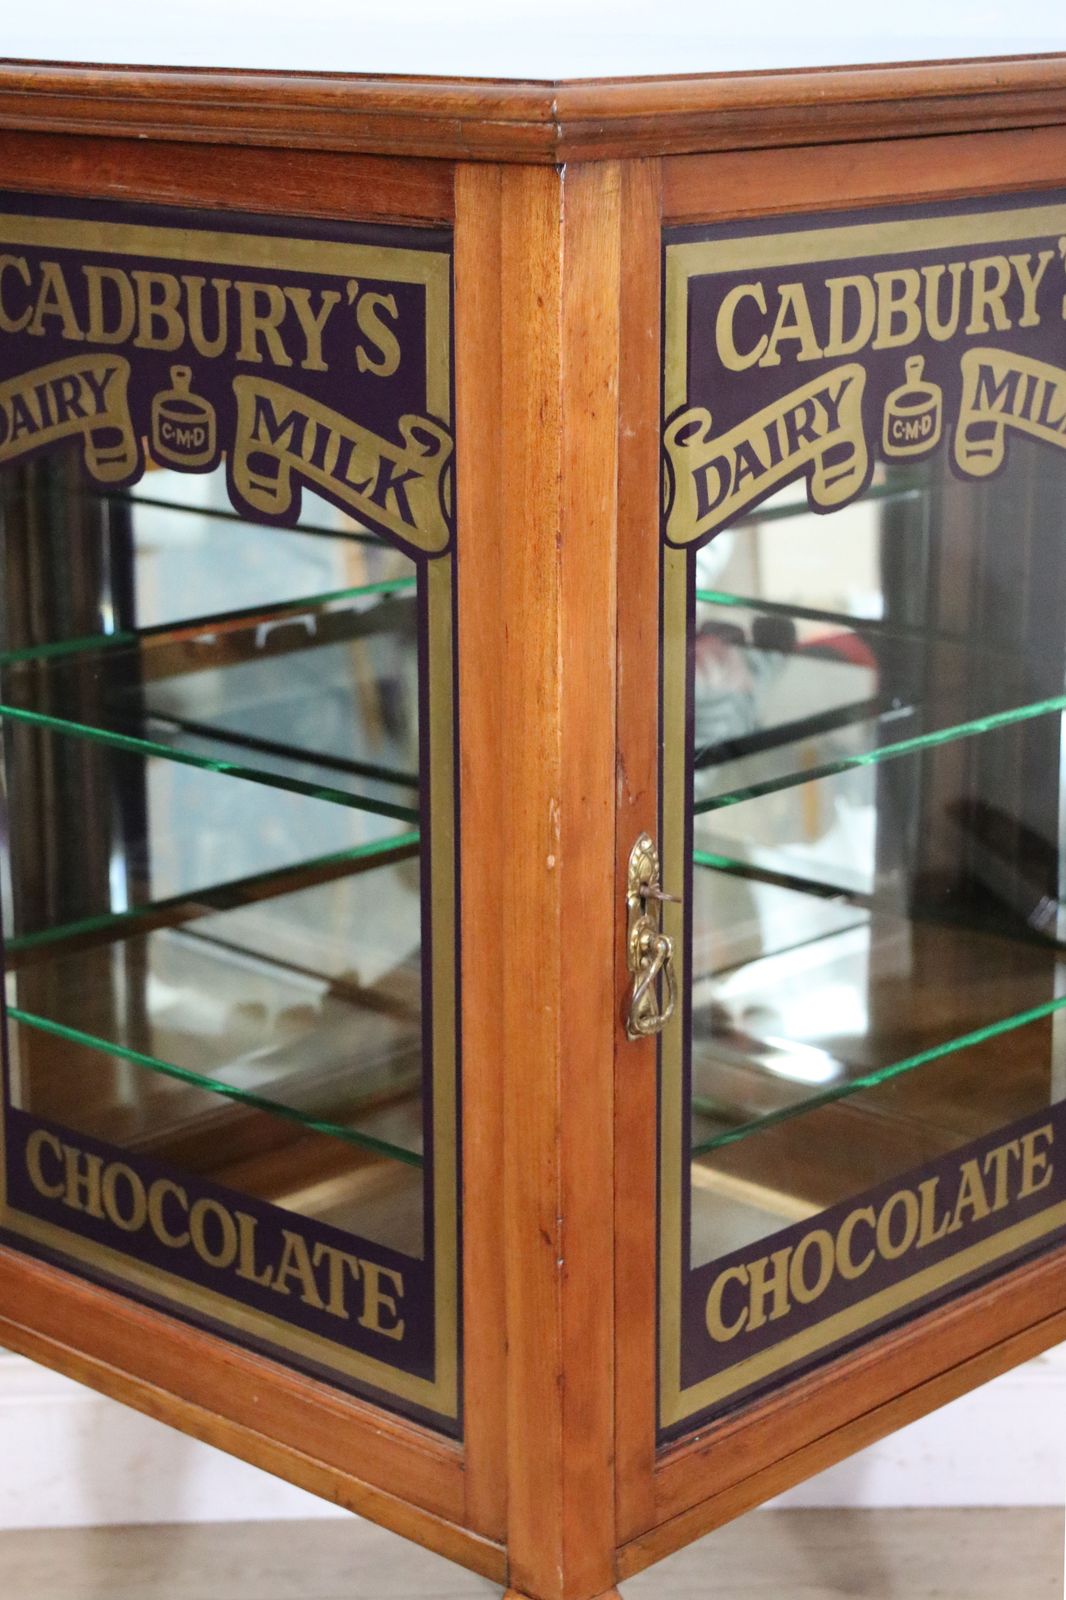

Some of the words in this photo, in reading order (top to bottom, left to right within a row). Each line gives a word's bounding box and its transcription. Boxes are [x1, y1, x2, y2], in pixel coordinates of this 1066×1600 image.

[0, 254, 401, 377] CADBURY'S
[715, 236, 1066, 372] CADBURY'
[0, 367, 118, 447] AIRY
[249, 394, 426, 528] MILK
[691, 377, 854, 522] DAIRY
[971, 364, 1066, 435] MIL
[26, 1130, 406, 1341] CHOCOLATE
[705, 1124, 1054, 1343] CHOCOLATE
